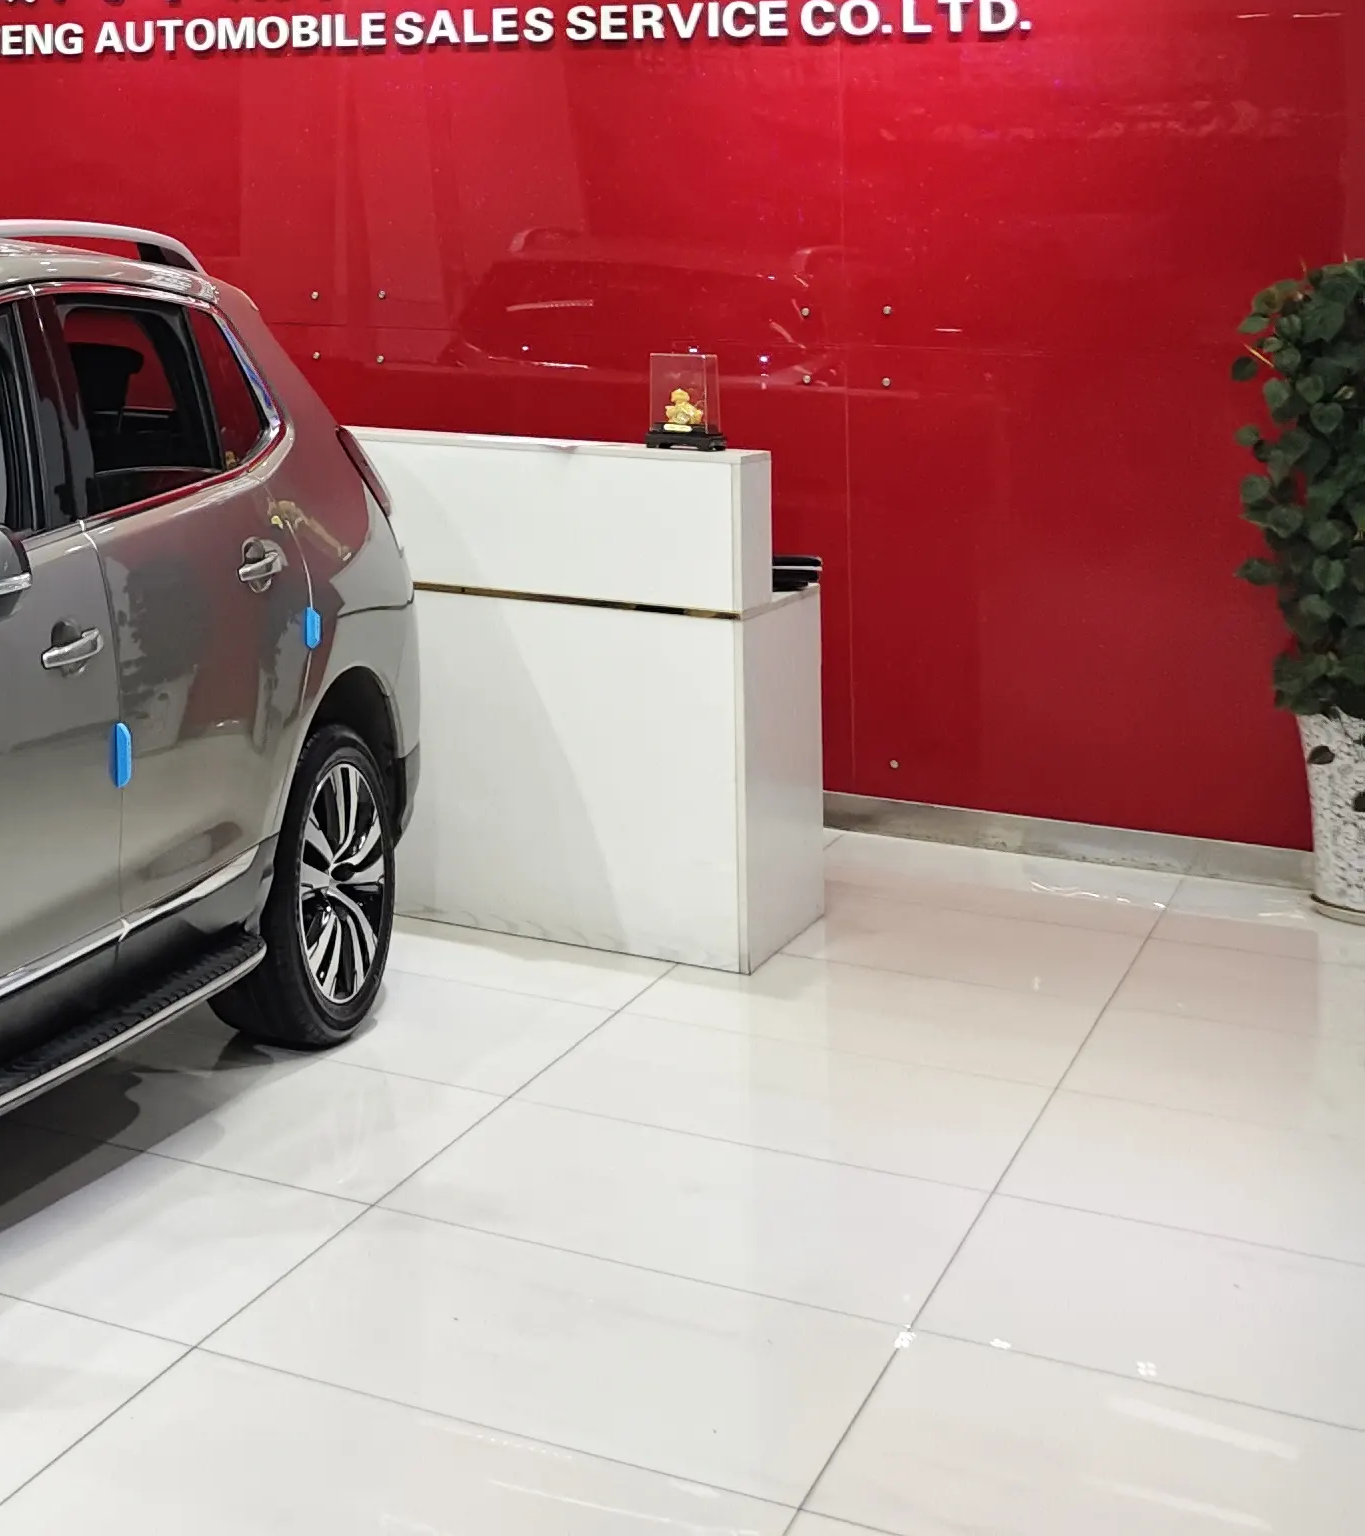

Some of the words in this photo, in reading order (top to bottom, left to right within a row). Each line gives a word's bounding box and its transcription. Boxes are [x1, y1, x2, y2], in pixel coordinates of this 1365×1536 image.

[95, 13, 386, 53] AUTOMOBILE
[395, 7, 553, 45] SALES
[566, 1, 788, 40] SERVICE
